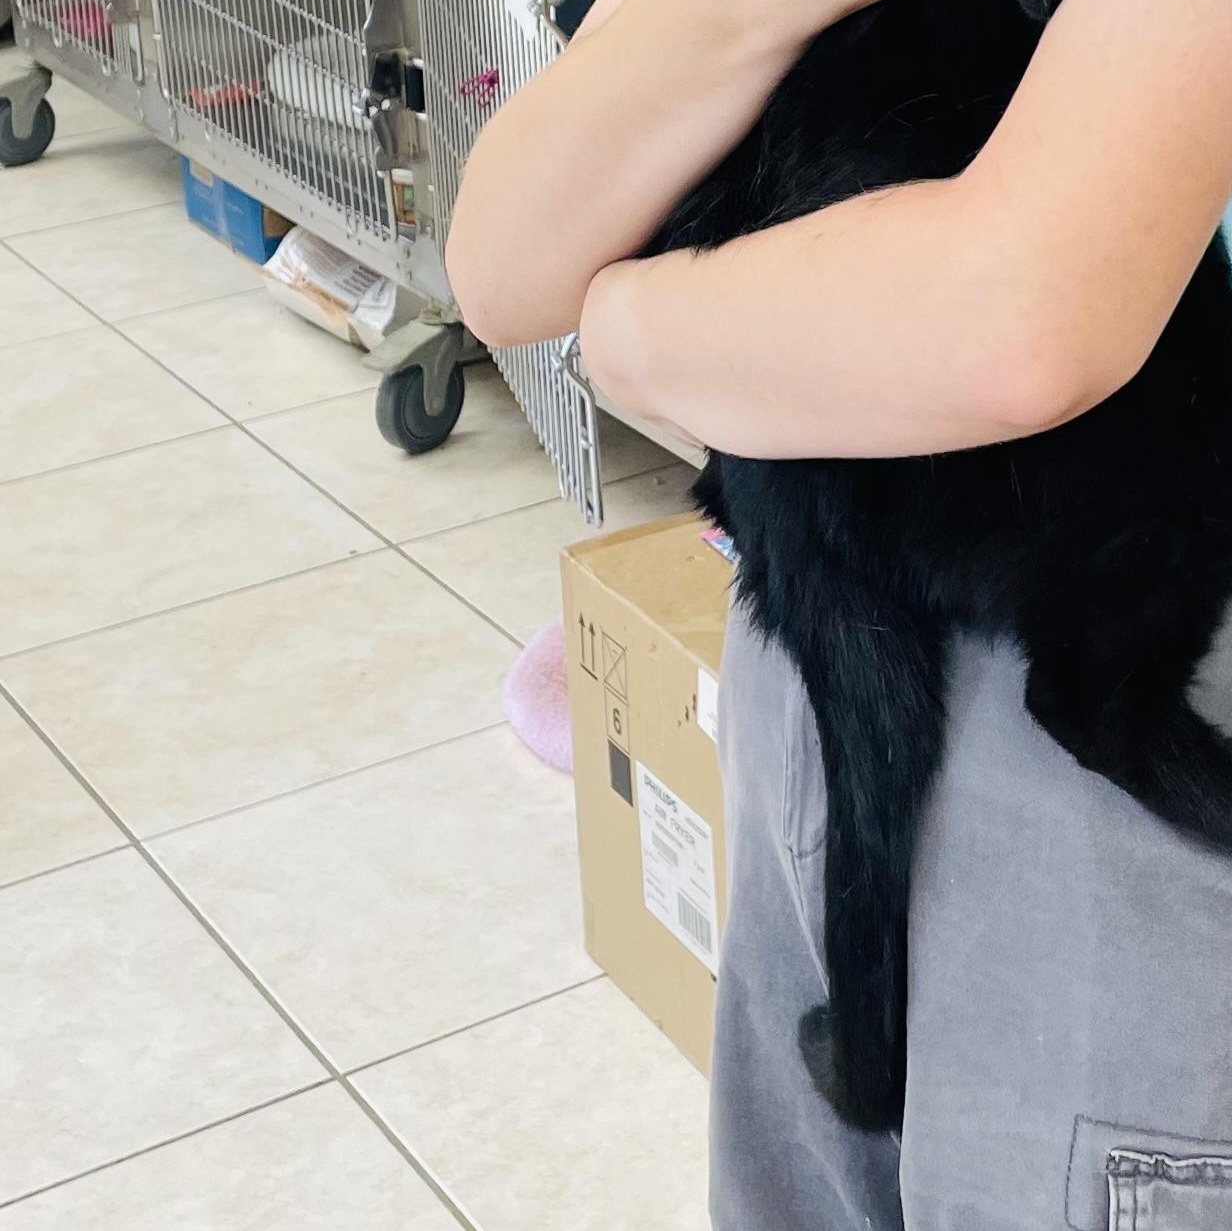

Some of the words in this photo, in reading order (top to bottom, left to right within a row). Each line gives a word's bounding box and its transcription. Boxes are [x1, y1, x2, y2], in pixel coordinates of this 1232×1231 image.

[612, 707, 622, 736] 6
[643, 773, 678, 814] PHILIPS
[669, 816, 696, 848] FRYER
